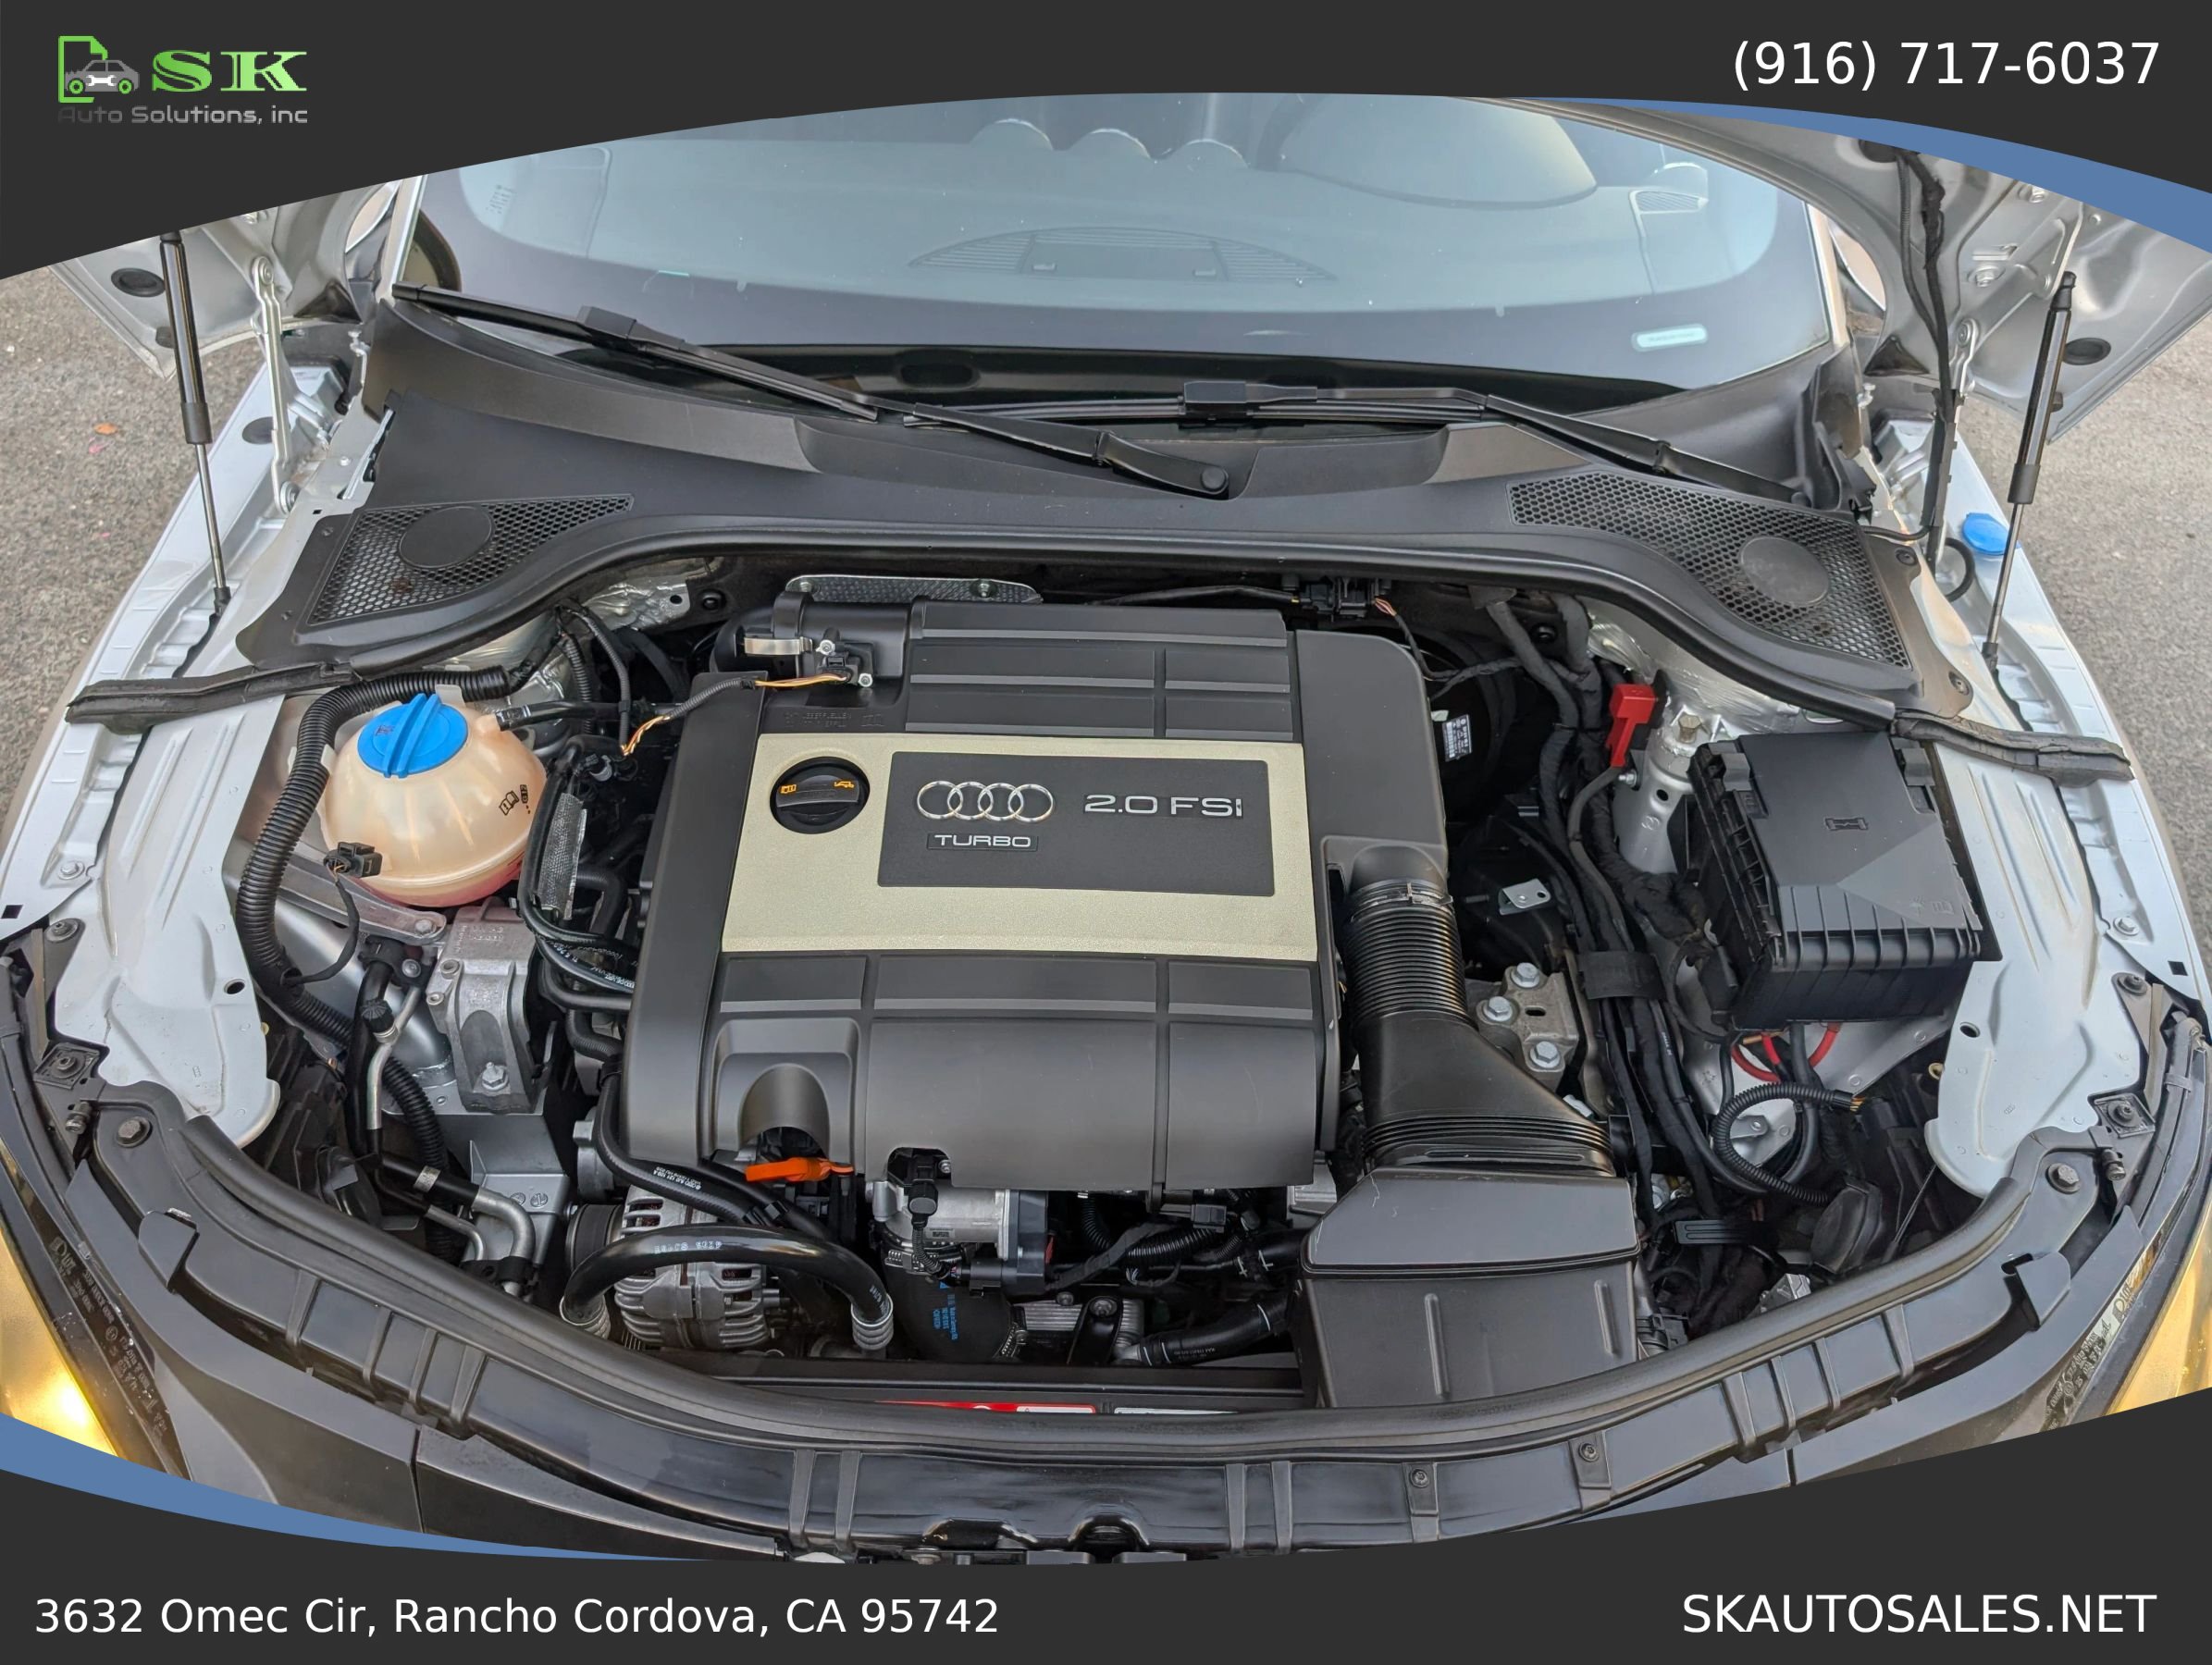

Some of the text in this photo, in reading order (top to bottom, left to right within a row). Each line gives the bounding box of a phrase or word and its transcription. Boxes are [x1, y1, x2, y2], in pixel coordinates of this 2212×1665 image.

[1084, 794, 1242, 817] 2.0 FSI
[934, 834, 1032, 847] TURBO
